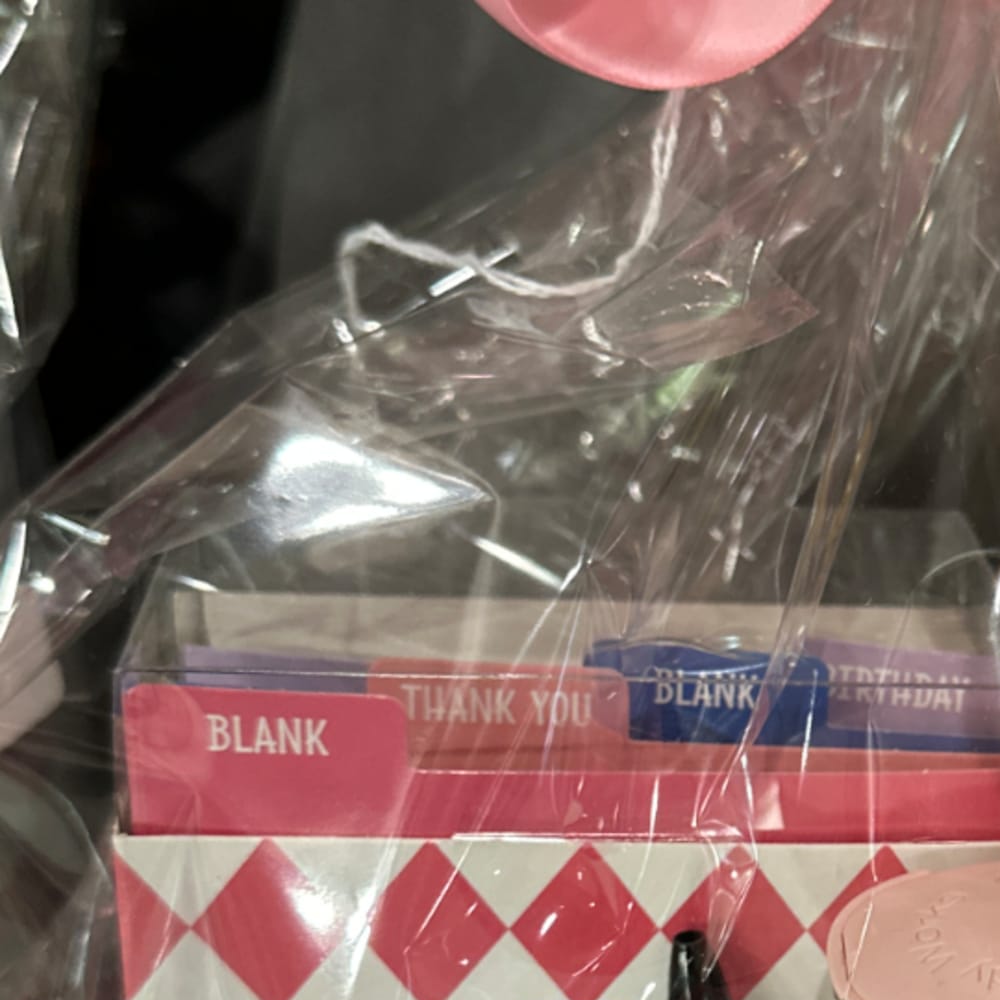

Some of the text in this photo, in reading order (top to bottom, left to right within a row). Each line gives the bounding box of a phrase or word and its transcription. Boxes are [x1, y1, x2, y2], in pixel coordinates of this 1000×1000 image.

[400, 684, 592, 727] THANK YOU
[654, 667, 759, 710] BLANK
[206, 714, 329, 756] BLANK
